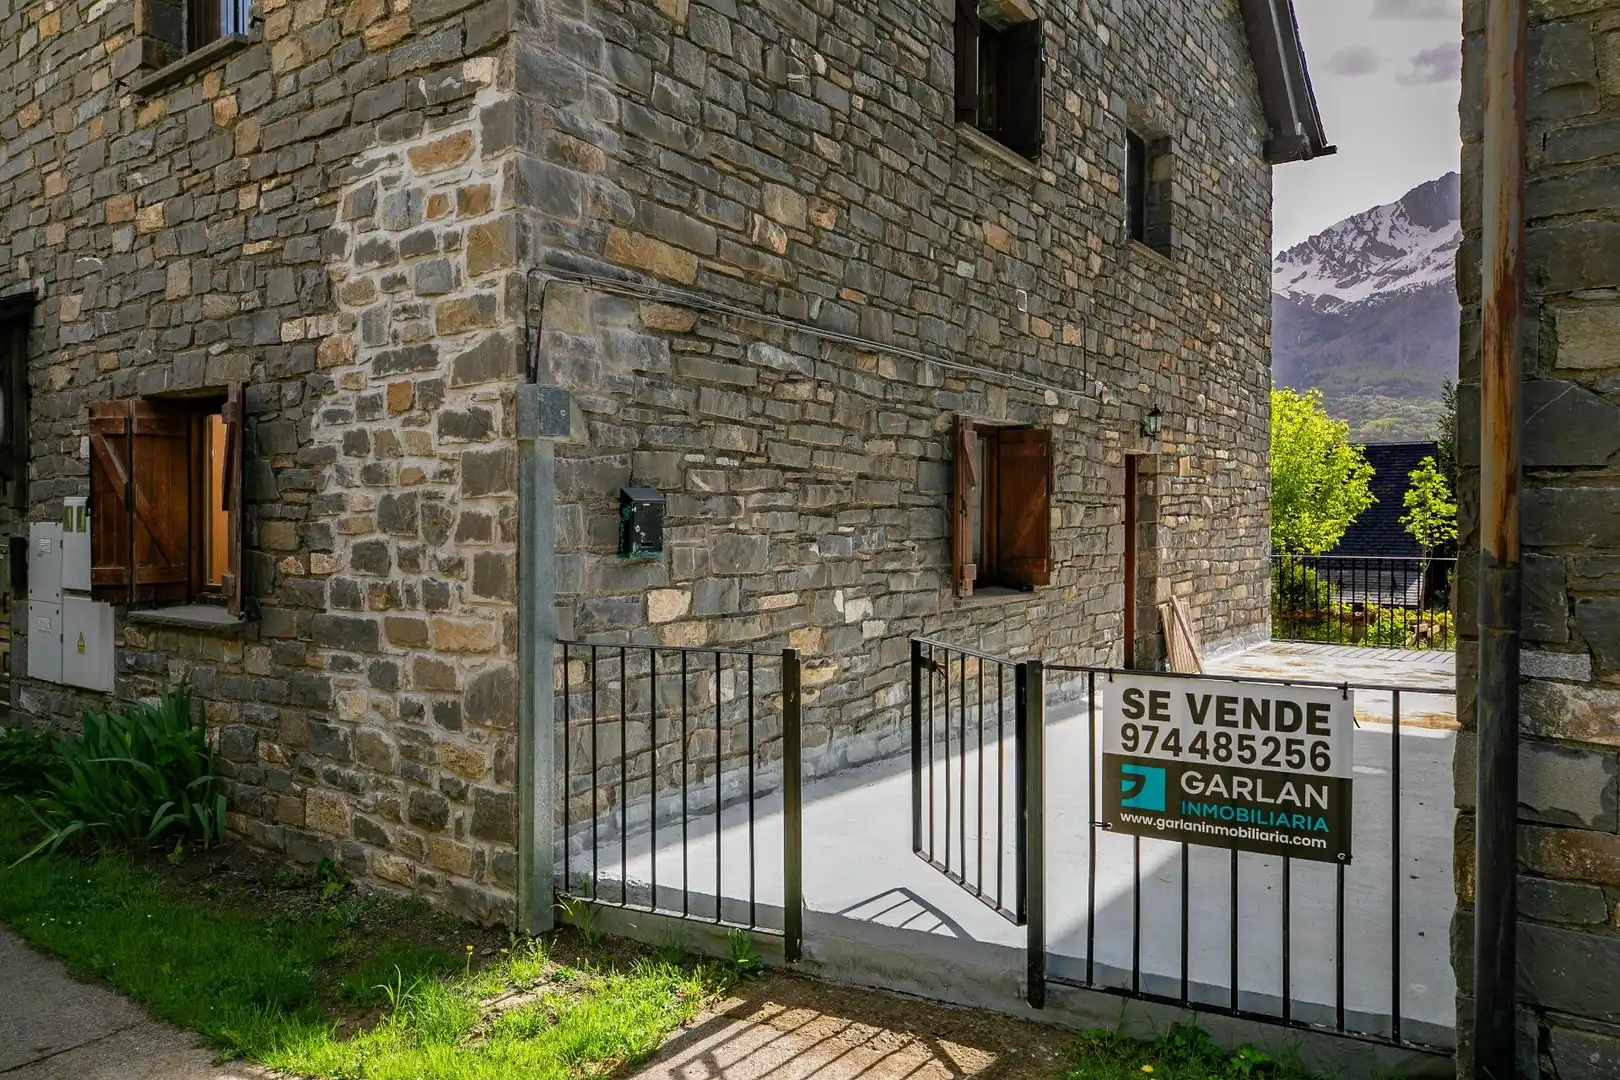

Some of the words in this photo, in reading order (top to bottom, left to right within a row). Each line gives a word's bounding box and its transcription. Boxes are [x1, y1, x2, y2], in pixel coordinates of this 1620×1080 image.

[1122, 688, 1171, 721] SE
[1186, 693, 1331, 737] VENDE
[1180, 770, 1328, 810] GARLAN
[1120, 812, 1327, 849] www.garlaninmobiliaria.com
[1181, 801, 1329, 832] INMOBILIARIA
